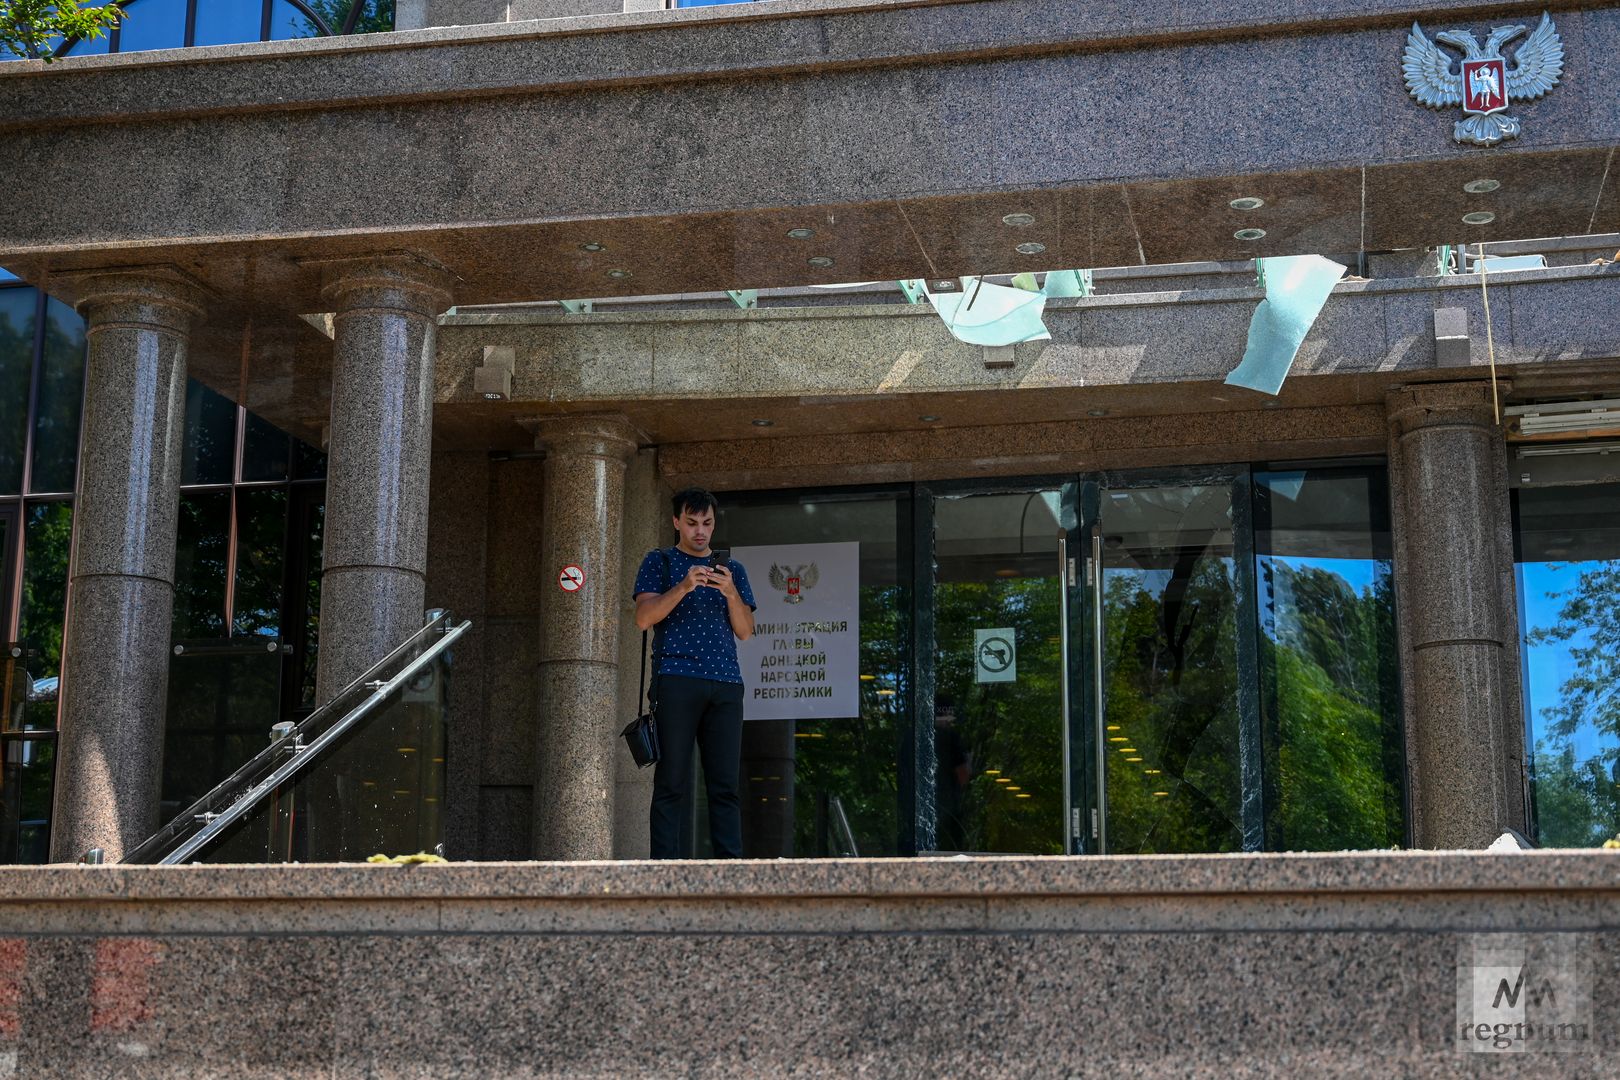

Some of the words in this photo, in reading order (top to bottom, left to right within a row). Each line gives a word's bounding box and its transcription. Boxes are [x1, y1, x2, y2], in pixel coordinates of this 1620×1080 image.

[751, 620, 848, 637] ДМИНИСТРАЦИЯ
[772, 637, 814, 651] ГЛВЫ
[760, 667, 826, 684] НАРОДНОЙ
[753, 686, 832, 700] РЕСПУБЛИКИ
